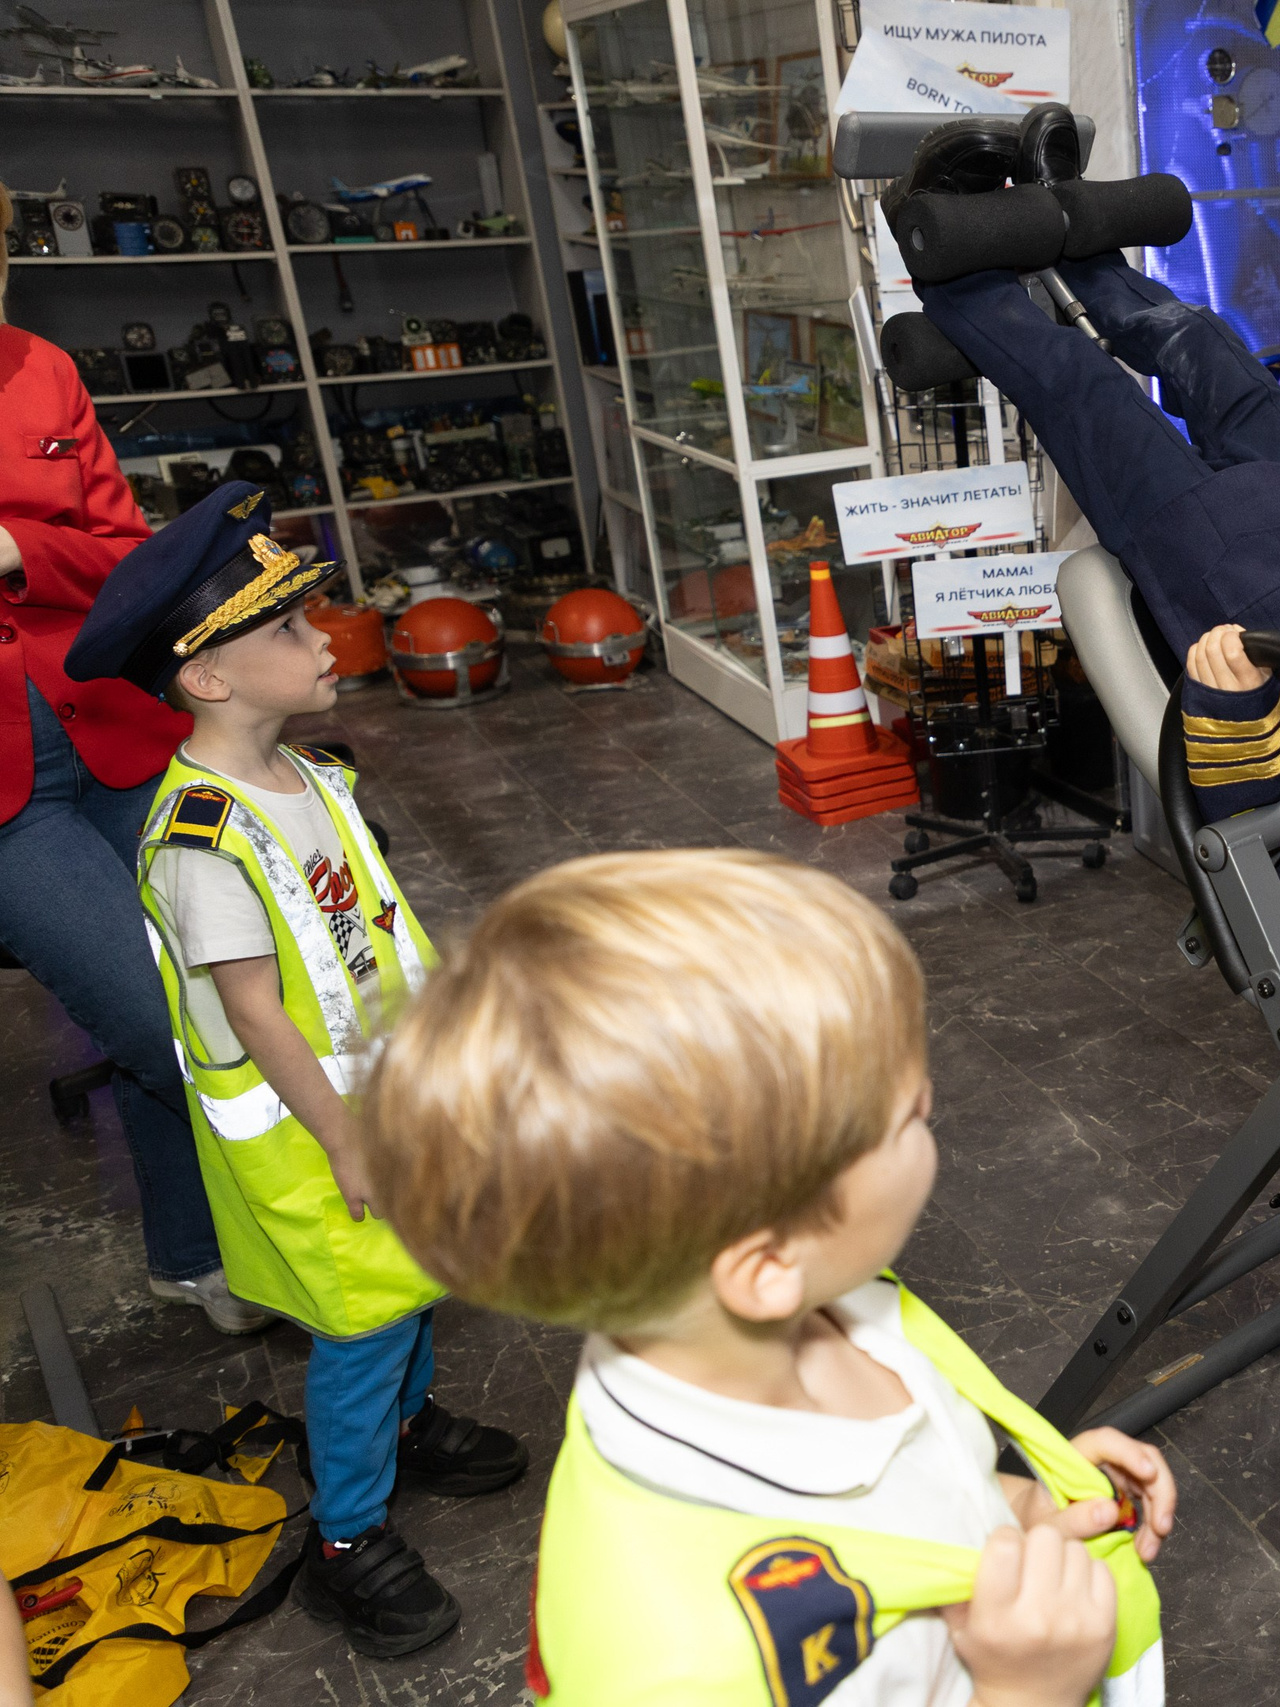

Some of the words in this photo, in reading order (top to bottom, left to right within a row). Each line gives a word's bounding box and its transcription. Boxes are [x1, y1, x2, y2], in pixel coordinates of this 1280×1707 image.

[883, 24, 922, 41] ИЩУ
[926, 27, 977, 43] МУЖА
[981, 30, 1047, 47] ПИЛОТА
[906, 78, 950, 107] BORN
[954, 100, 973, 113] TO
[845, 501, 889, 517] ЖИТЬ
[900, 492, 960, 510] ЗНАЧИТ
[963, 484, 1022, 503] ЛЕТАТЬ!
[909, 526, 969, 544] АВИАТОР
[982, 566, 1034, 579] МАМА!
[935, 592, 945, 603] Я
[949, 587, 1014, 602] ЛЁТЧИКА
[980, 607, 1039, 622] АВИАТОР
